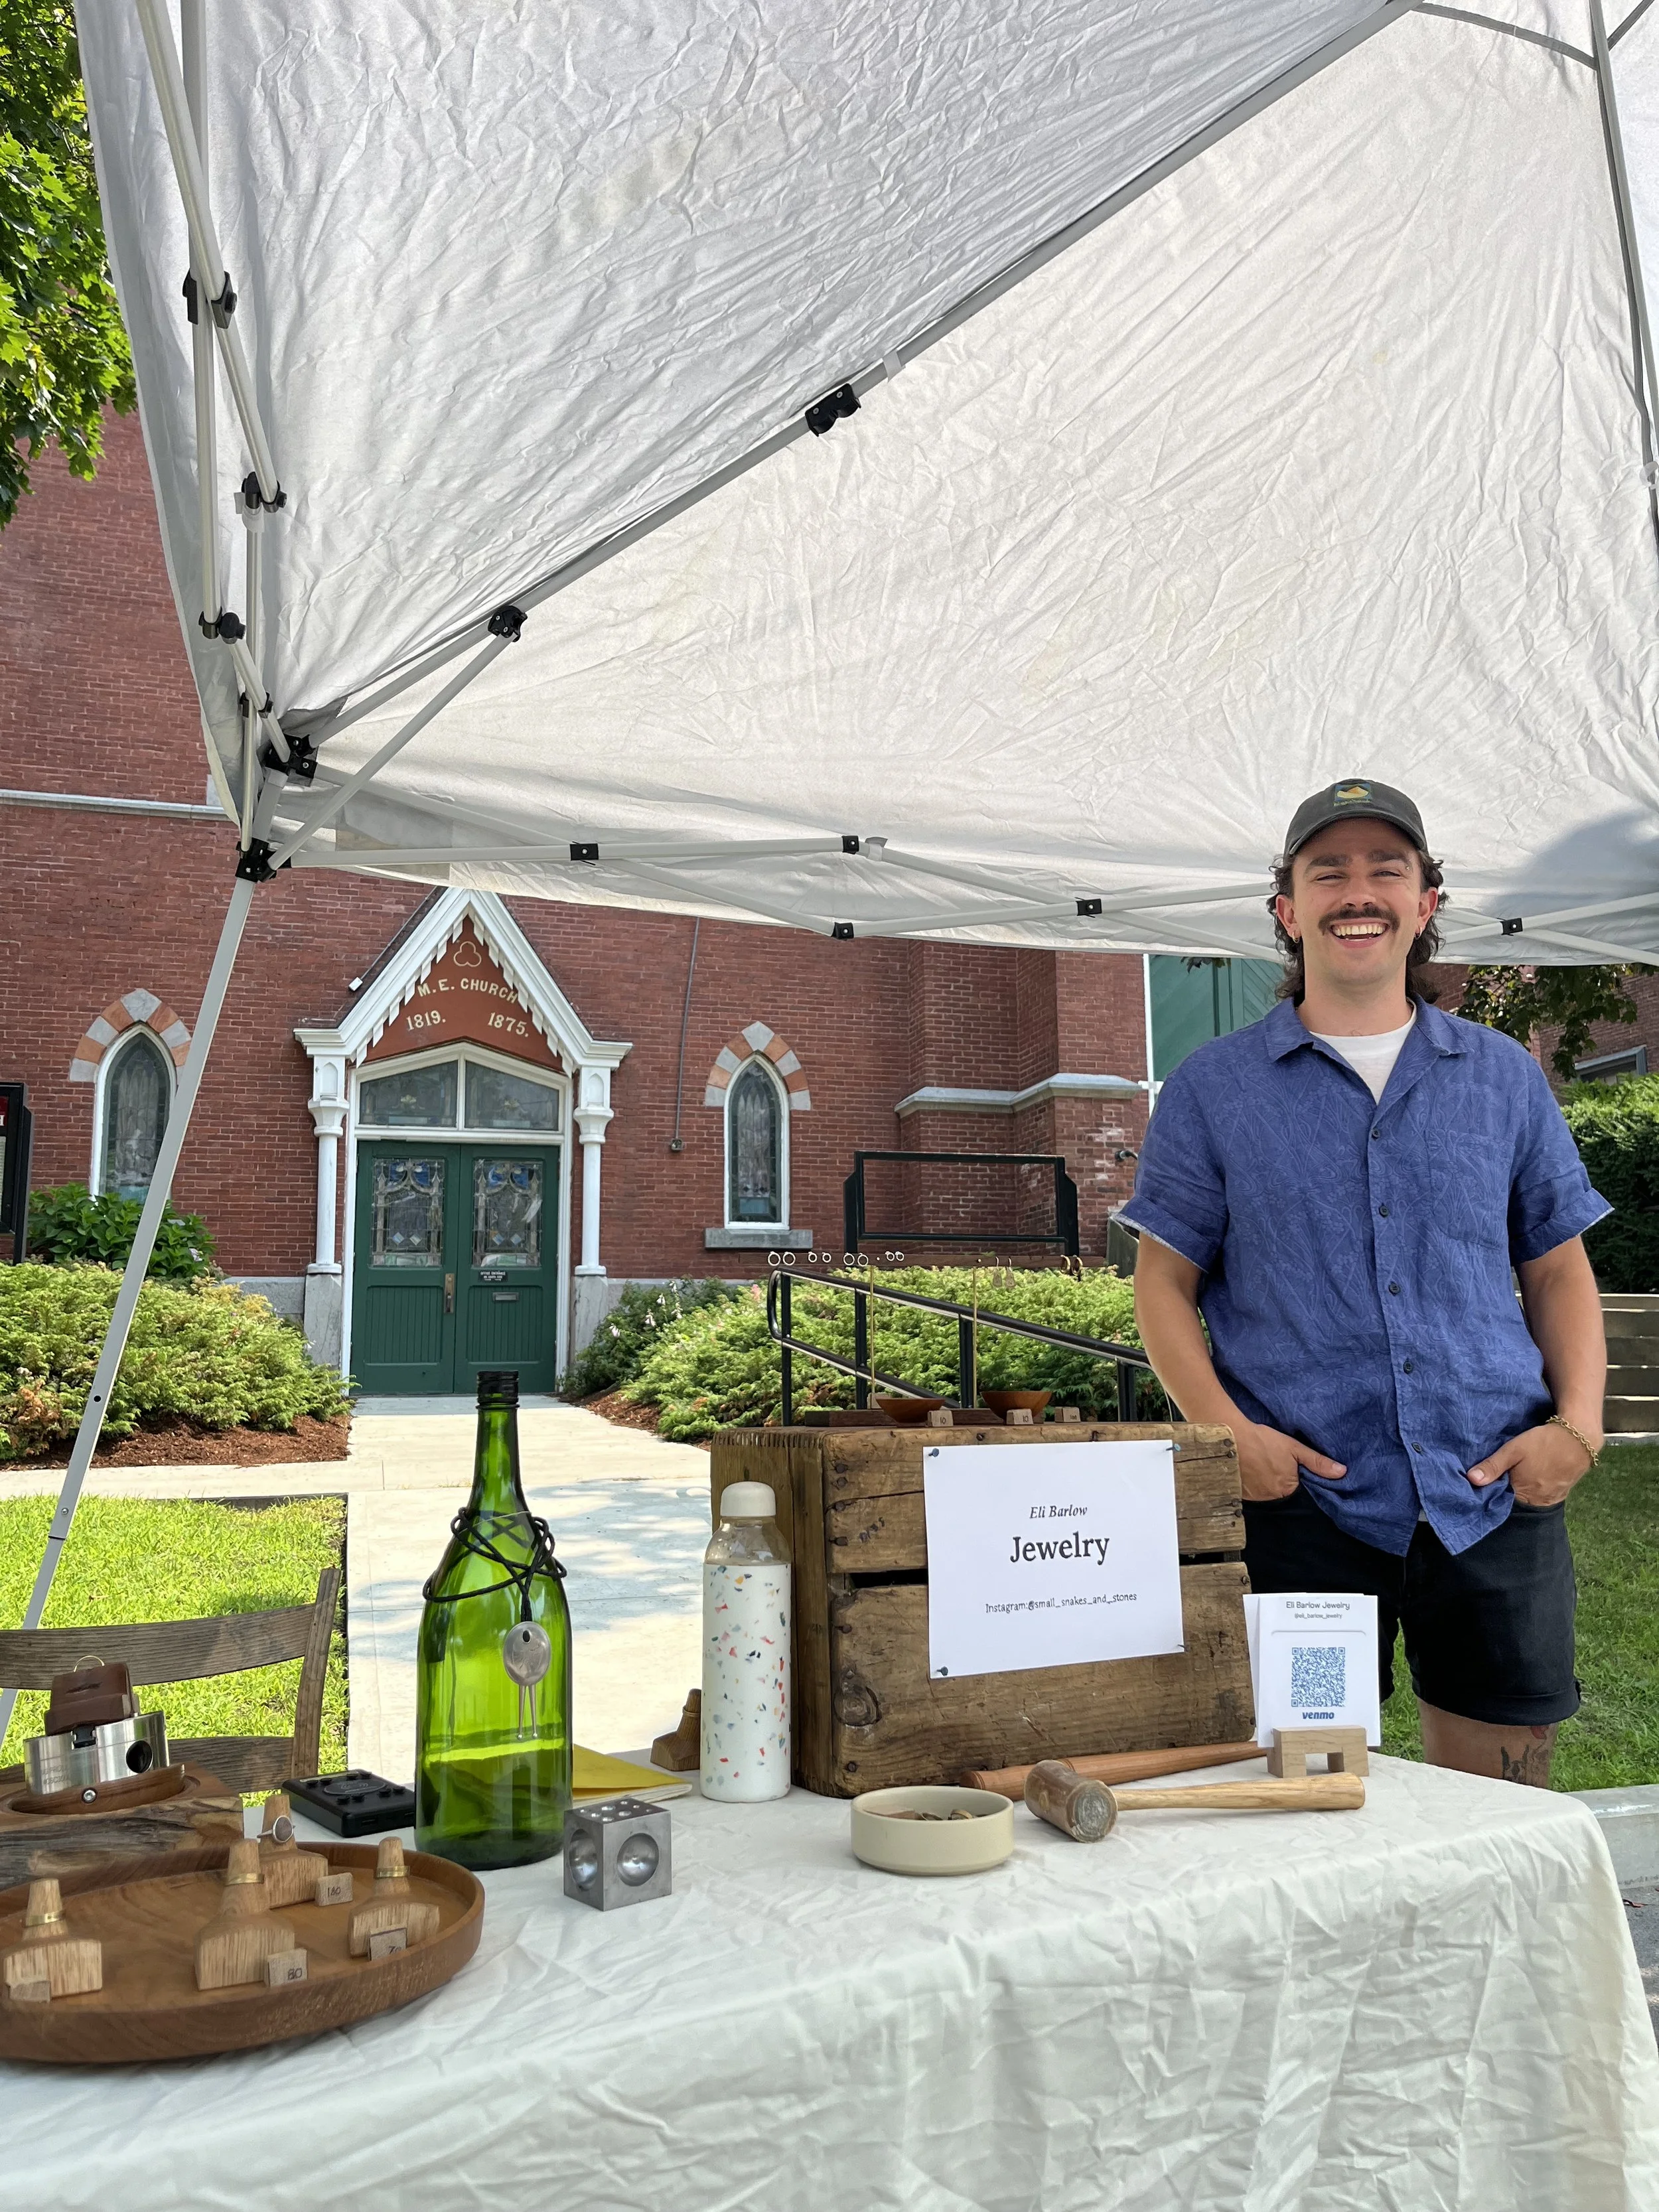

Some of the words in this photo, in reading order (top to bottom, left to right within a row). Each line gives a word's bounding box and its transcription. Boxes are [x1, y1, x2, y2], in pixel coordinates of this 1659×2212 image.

[461, 978, 519, 1004] CHURCH
[1029, 1505, 1046, 1519] Eli
[1048, 1504, 1088, 1518] Barlow
[1009, 1530, 1110, 1566] Jewelry
[1322, 1601, 1350, 1611] Jewelry
